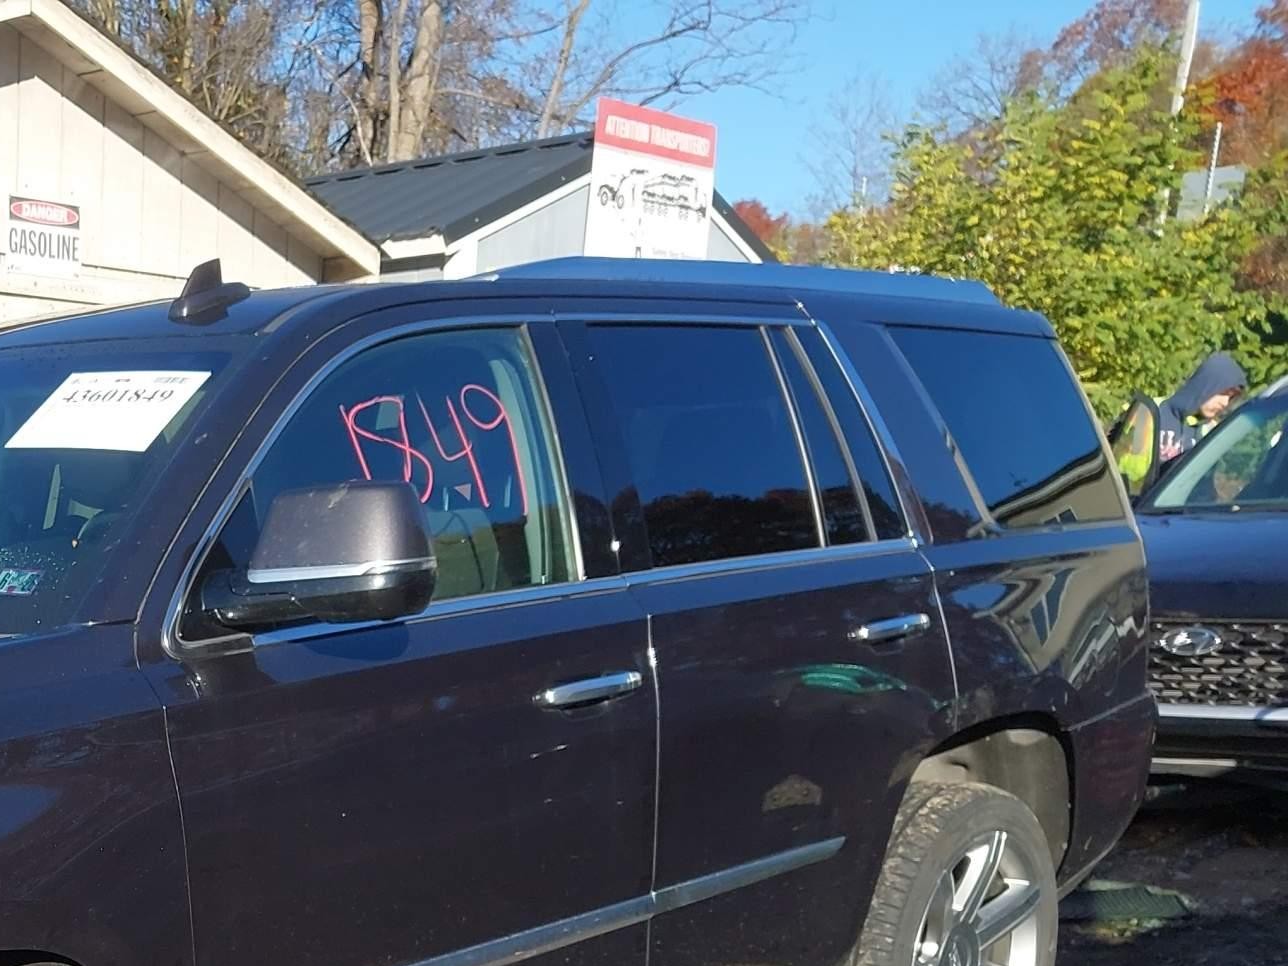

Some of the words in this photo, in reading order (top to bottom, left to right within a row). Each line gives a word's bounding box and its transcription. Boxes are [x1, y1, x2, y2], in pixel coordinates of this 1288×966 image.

[21, 203, 68, 223] DANGER
[9, 227, 80, 262] GASOLINE
[63, 389, 175, 403] 43601849
